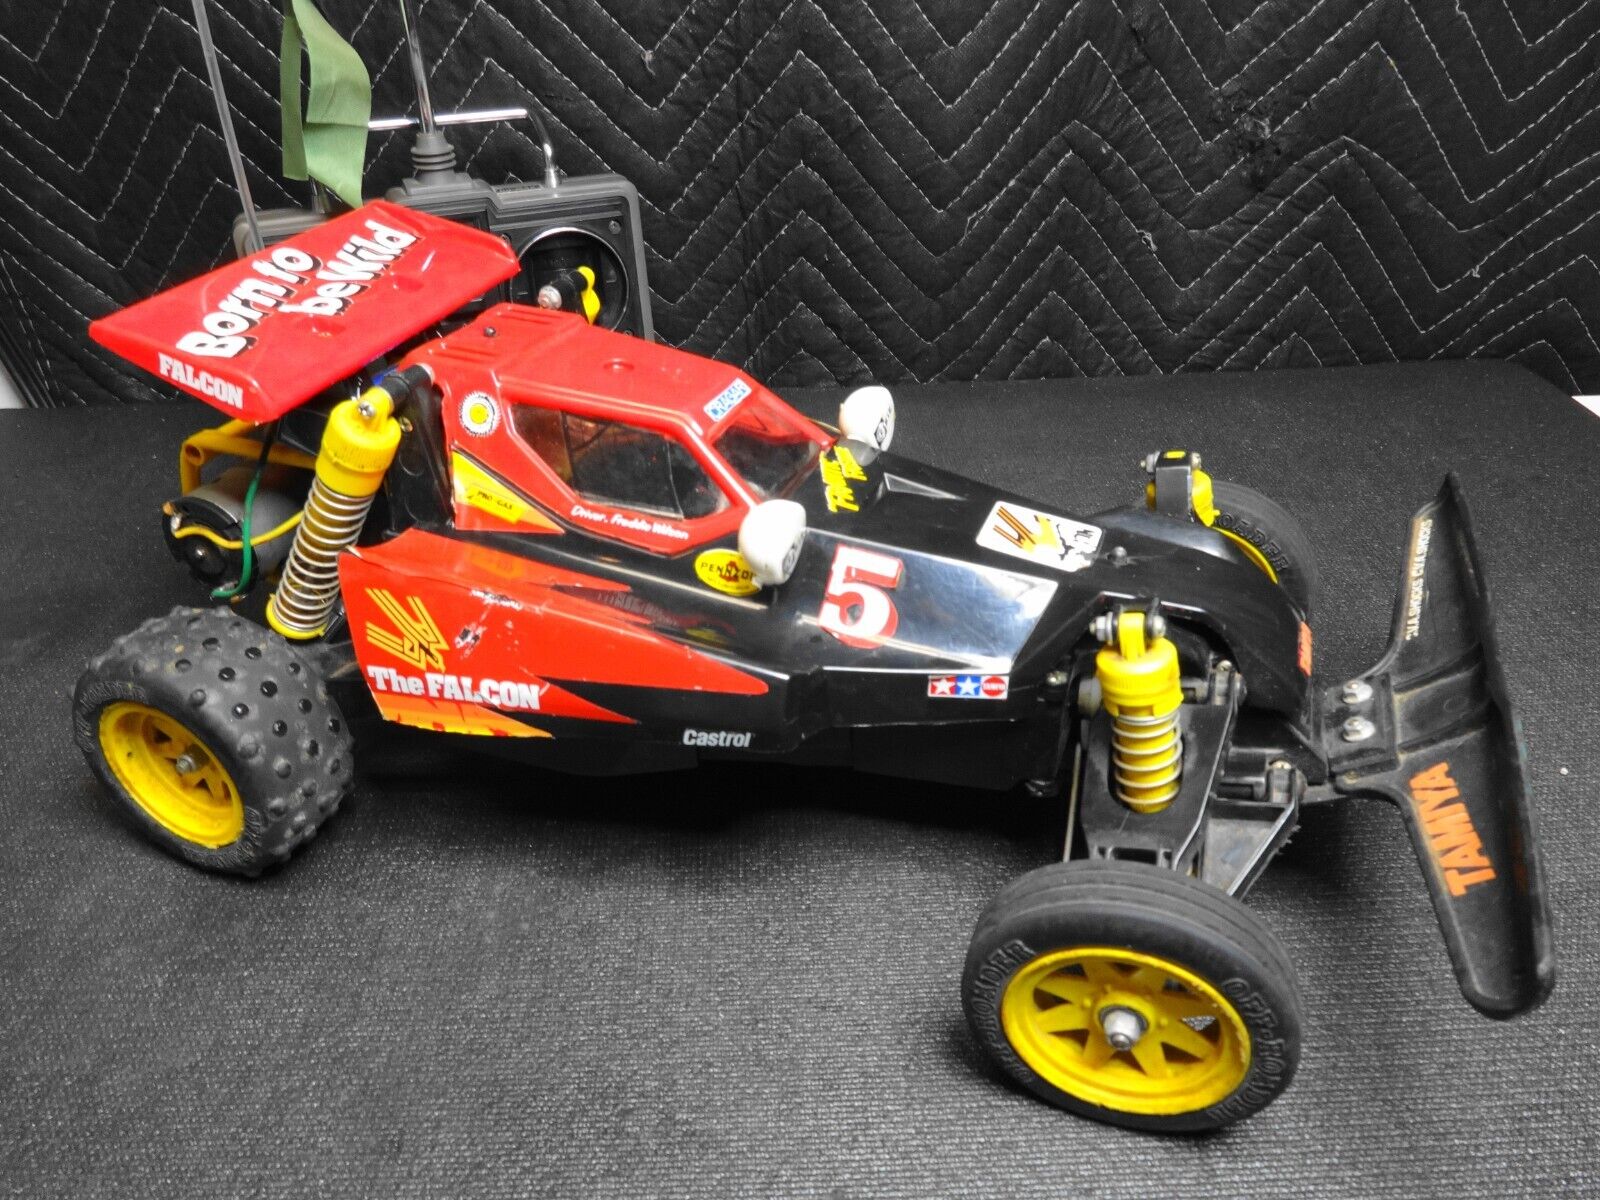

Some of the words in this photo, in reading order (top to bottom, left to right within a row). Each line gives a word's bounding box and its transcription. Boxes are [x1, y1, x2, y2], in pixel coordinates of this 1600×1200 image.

[176, 276, 288, 358] Born
[251, 246, 316, 288] to
[157, 352, 244, 410] FALCON
[817, 543, 904, 650] 5
[366, 666, 425, 697] The
[426, 671, 541, 711] FALCON
[682, 728, 752, 749] Castrol
[1409, 761, 1497, 897] TAMIYA
